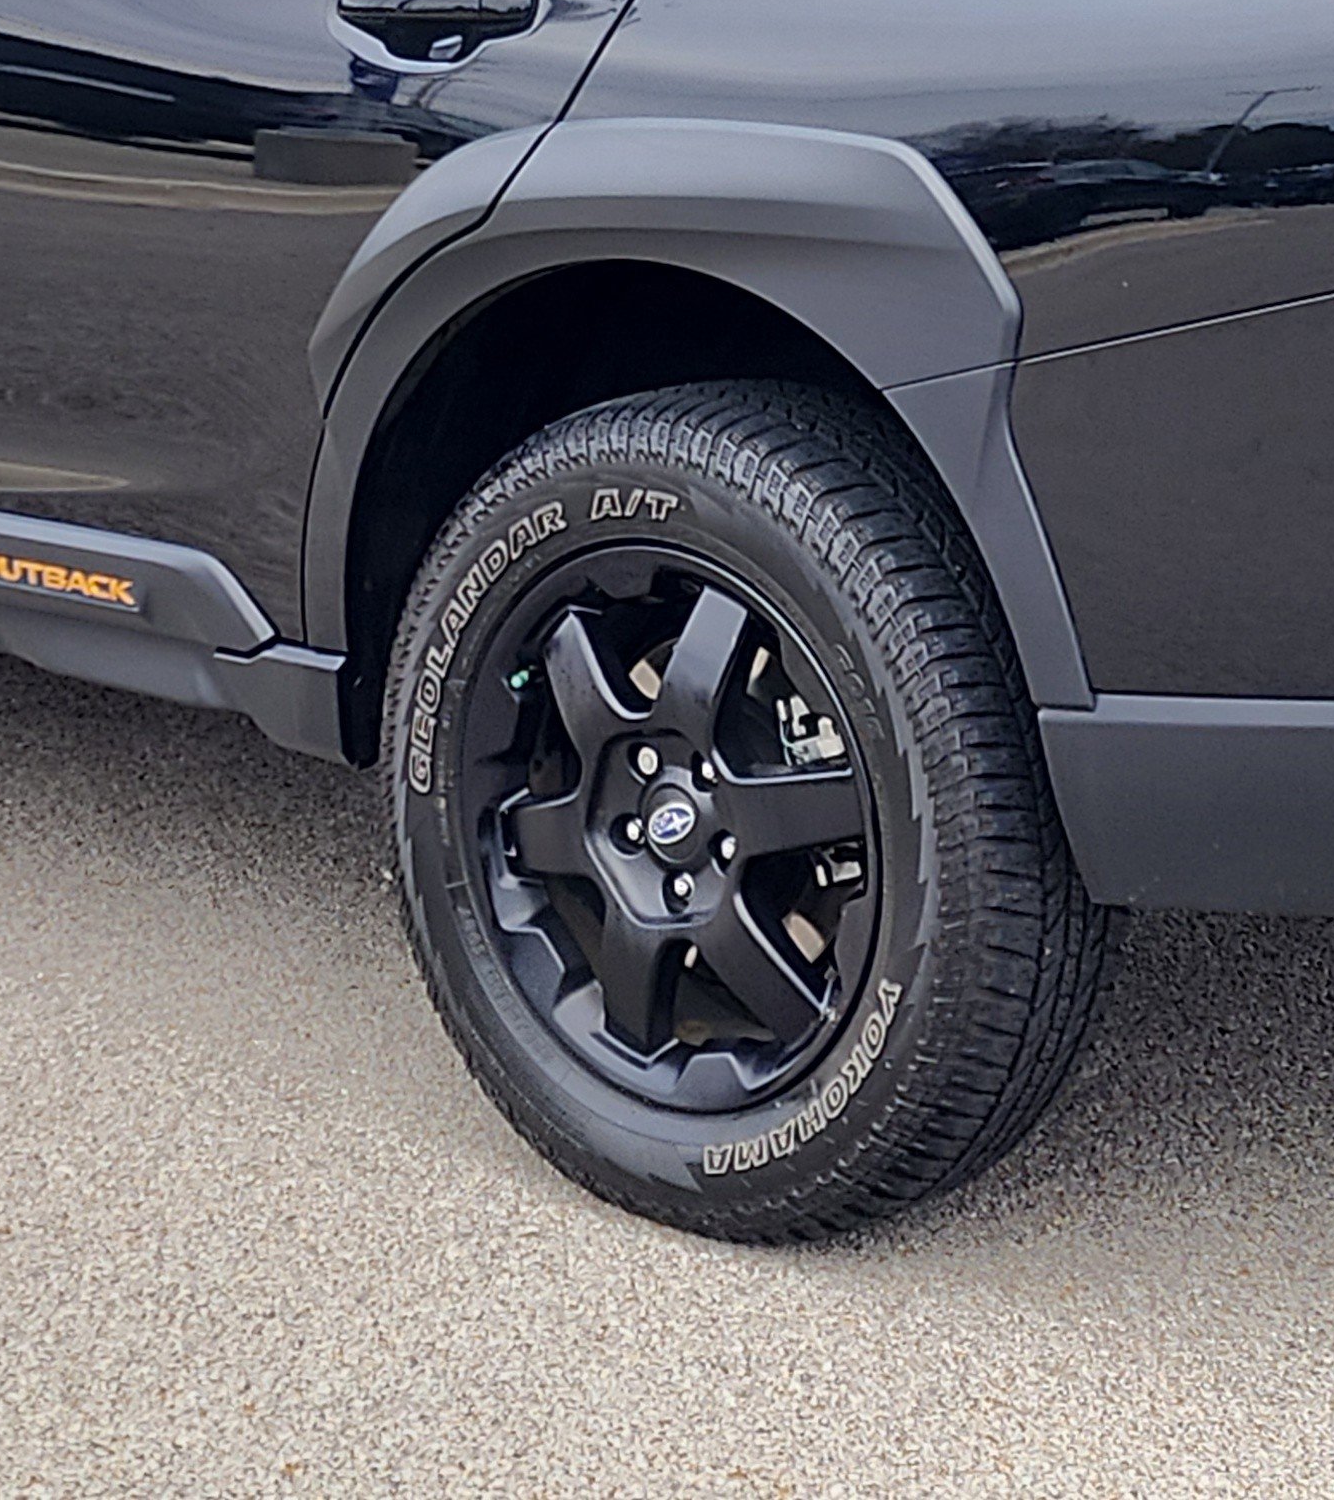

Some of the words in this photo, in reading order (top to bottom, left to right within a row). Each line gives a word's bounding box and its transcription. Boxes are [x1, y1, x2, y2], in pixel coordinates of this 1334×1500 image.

[408, 500, 568, 795] GEOLANDAR
[590, 487, 679, 522] A/T
[702, 977, 904, 1176] YOKOHAMA
